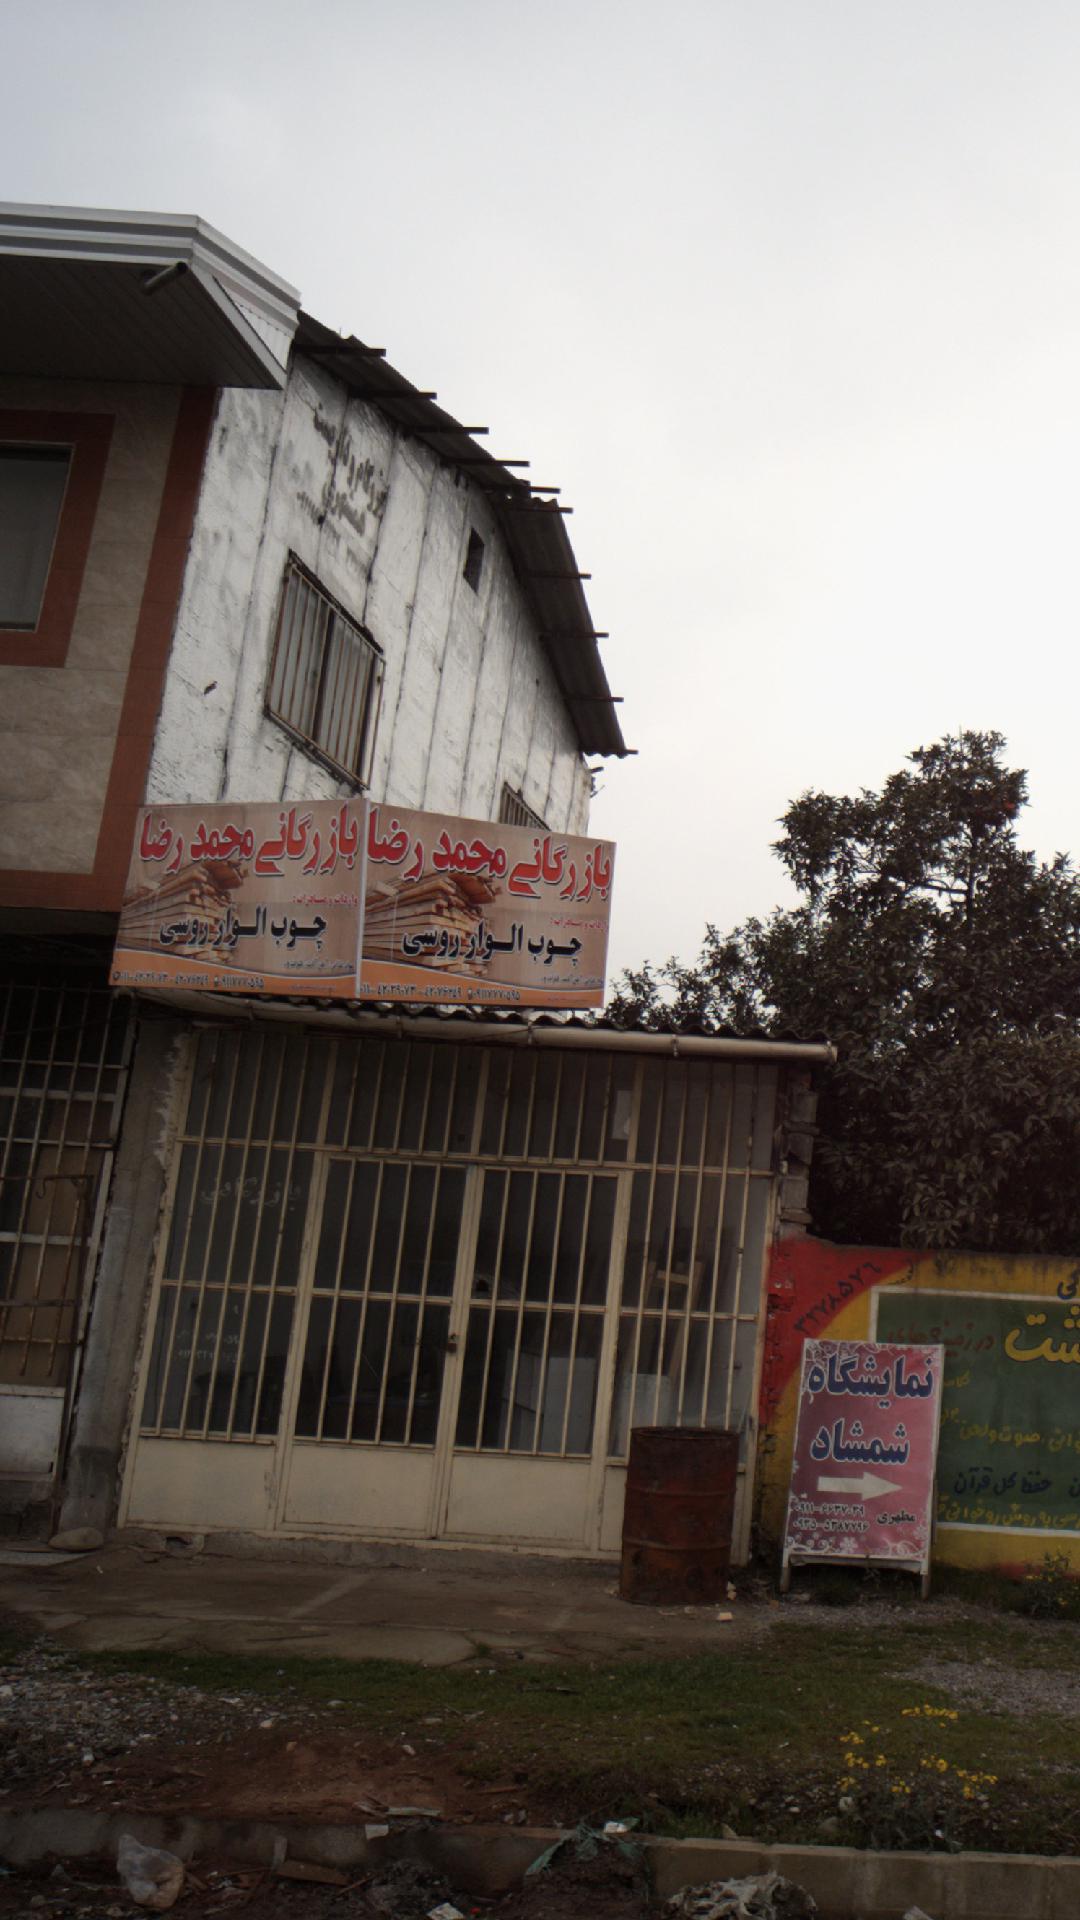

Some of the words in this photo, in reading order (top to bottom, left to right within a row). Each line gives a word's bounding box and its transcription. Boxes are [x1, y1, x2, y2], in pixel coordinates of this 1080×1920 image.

[139, 813, 185, 874] رضا
[189, 820, 255, 861] محمد
[253, 801, 361, 877] بازرگانی
[366, 807, 424, 881] رضا
[432, 830, 508, 878] محمد
[507, 835, 612, 903] بازرگانی
[159, 918, 209, 946] روسی
[212, 904, 267, 949] الوار
[271, 912, 328, 952] چوب
[402, 929, 461, 960] روسی
[466, 921, 525, 961] الوار
[527, 933, 583, 967] چوب
[807, 1353, 935, 1409] نمایشگاه
[809, 1418, 911, 1466] شمشاد
[876, 1508, 917, 1526] مطهری
